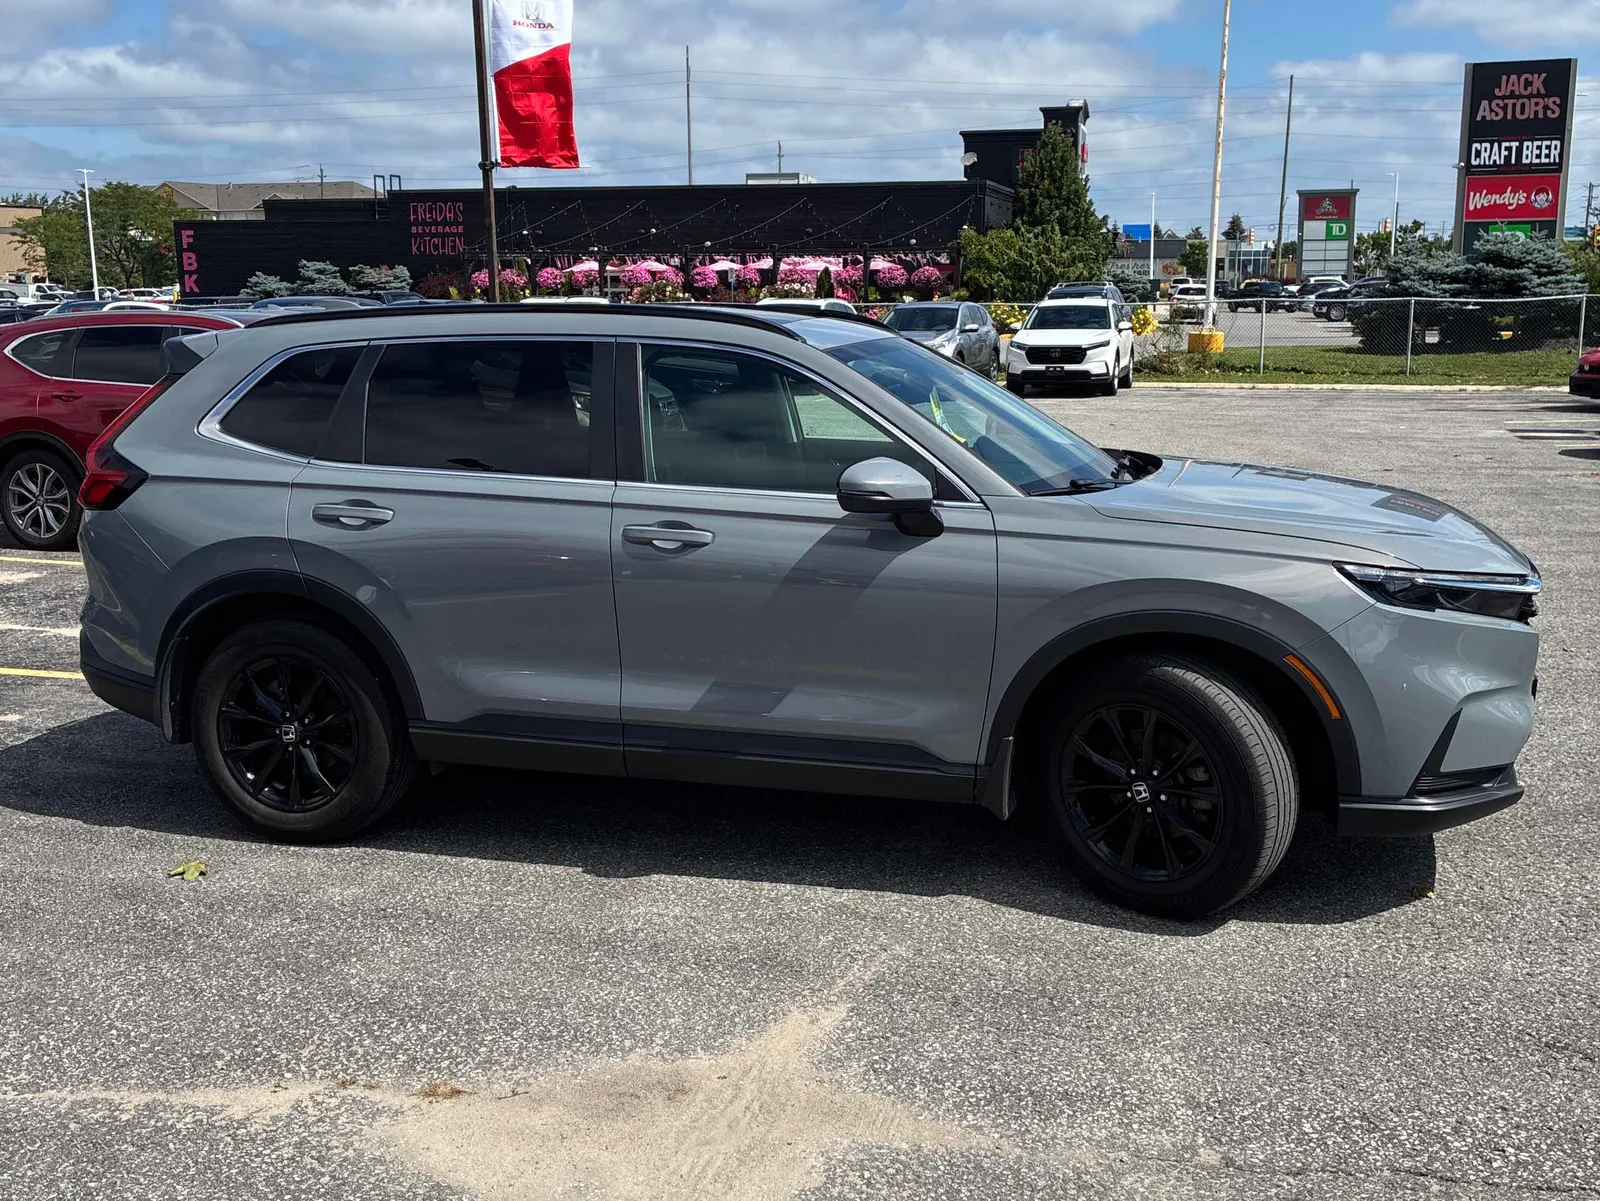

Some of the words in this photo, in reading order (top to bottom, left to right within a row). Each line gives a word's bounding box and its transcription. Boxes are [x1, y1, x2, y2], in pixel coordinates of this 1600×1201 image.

[512, 19, 555, 29] HONDA
[1494, 73, 1548, 97] JACK
[1476, 97, 1561, 121] ASTOR'S
[1470, 141, 1519, 166] CRAFT
[1522, 140, 1561, 164] BEER
[1469, 186, 1527, 211] Wendy's
[1329, 223, 1347, 235] TD
